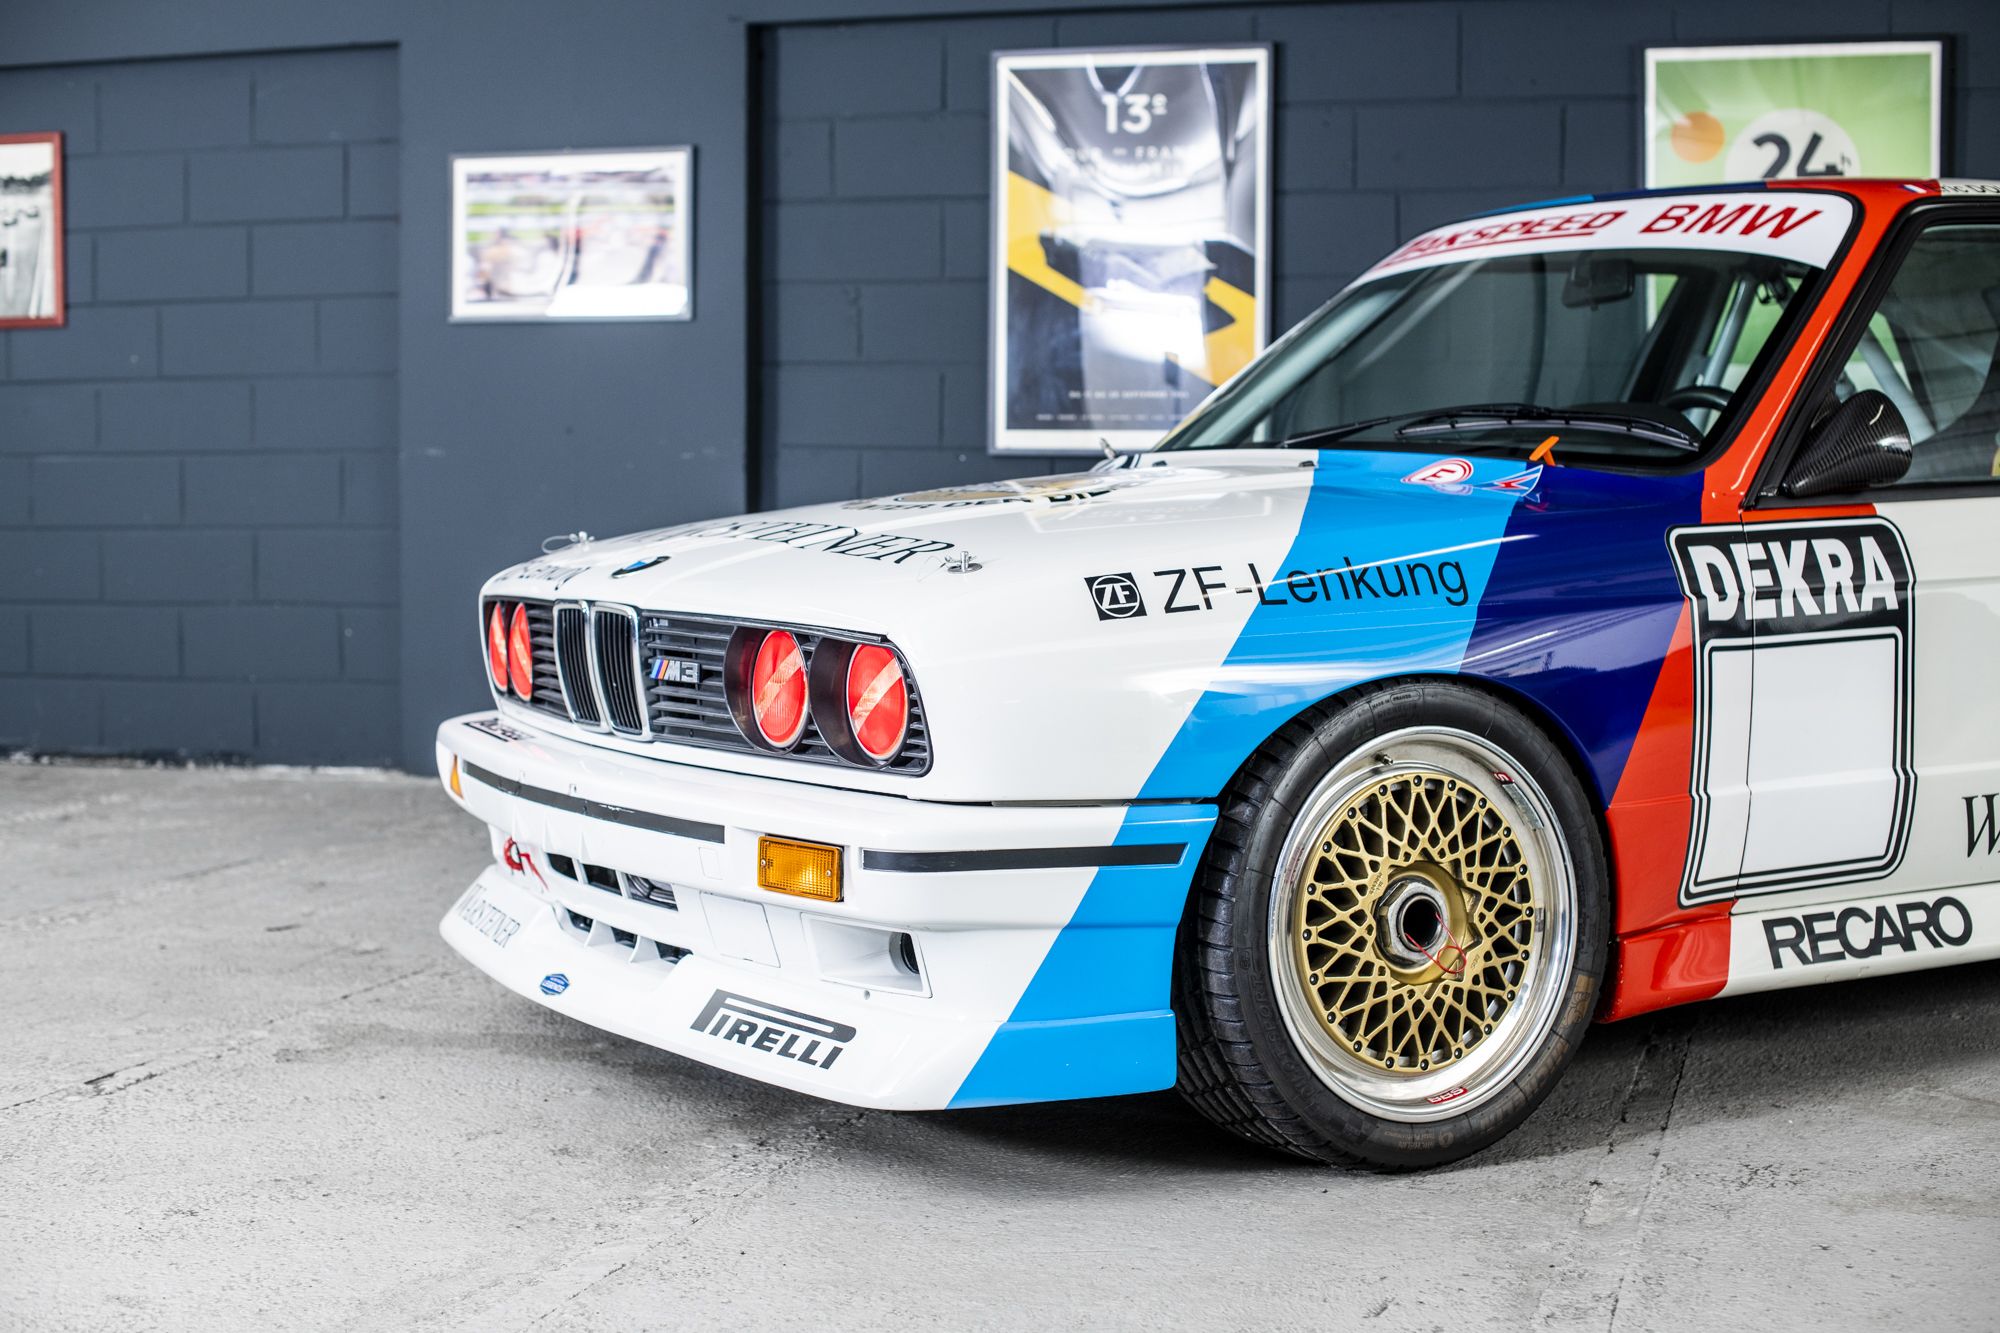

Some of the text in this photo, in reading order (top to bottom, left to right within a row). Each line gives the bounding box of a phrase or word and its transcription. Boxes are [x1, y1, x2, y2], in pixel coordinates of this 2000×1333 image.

[1639, 203, 1825, 239] BMW
[640, 520, 955, 564] STEINER
[1094, 556, 1470, 614] ZF ZF-Lenkung
[1687, 536, 1899, 622] DEKRA
[663, 659, 699, 683] M3
[1961, 792, 2000, 858] W
[1762, 896, 1974, 969] RECARO
[690, 989, 857, 1070] PIRELLI
